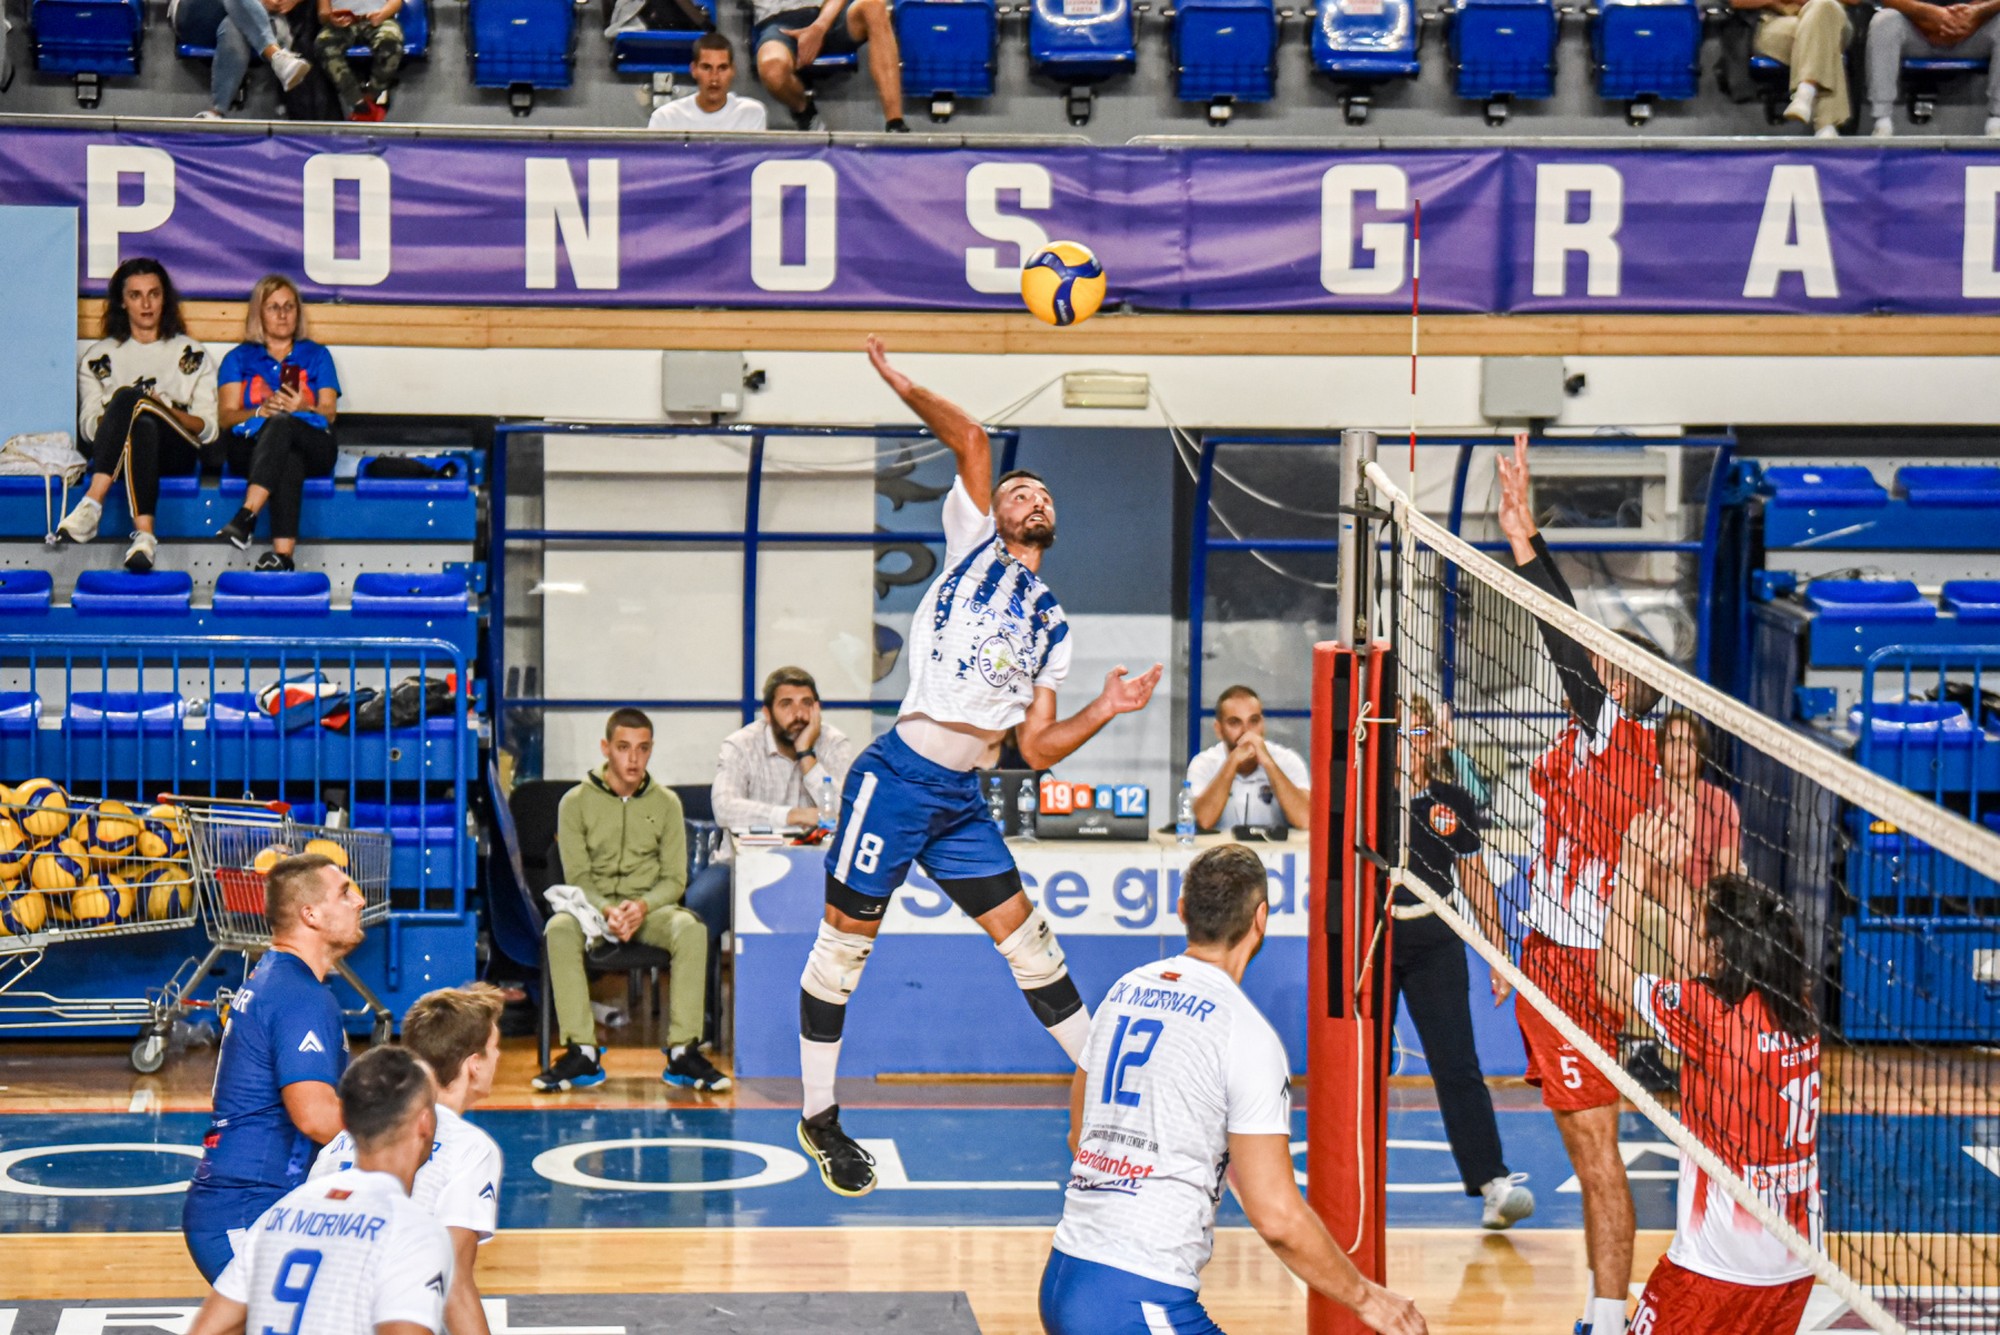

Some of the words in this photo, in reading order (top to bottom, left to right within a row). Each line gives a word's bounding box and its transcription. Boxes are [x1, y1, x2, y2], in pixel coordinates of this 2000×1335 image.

[87, 144, 1052, 294] PONOS
[1042, 784, 1071, 809] 19
[1075, 790, 1088, 806] 0
[1098, 790, 1110, 807] 0
[1116, 787, 1144, 812] 12
[854, 832, 884, 874] 8
[1128, 986, 1216, 1023] MORNAR
[1101, 1015, 1164, 1108] 12
[1560, 1056, 1582, 1089] 5
[1779, 1071, 1820, 1149] 16
[289, 1209, 386, 1241] MORNAR
[262, 1248, 323, 1335] 9
[1630, 1299, 1656, 1335] 16
